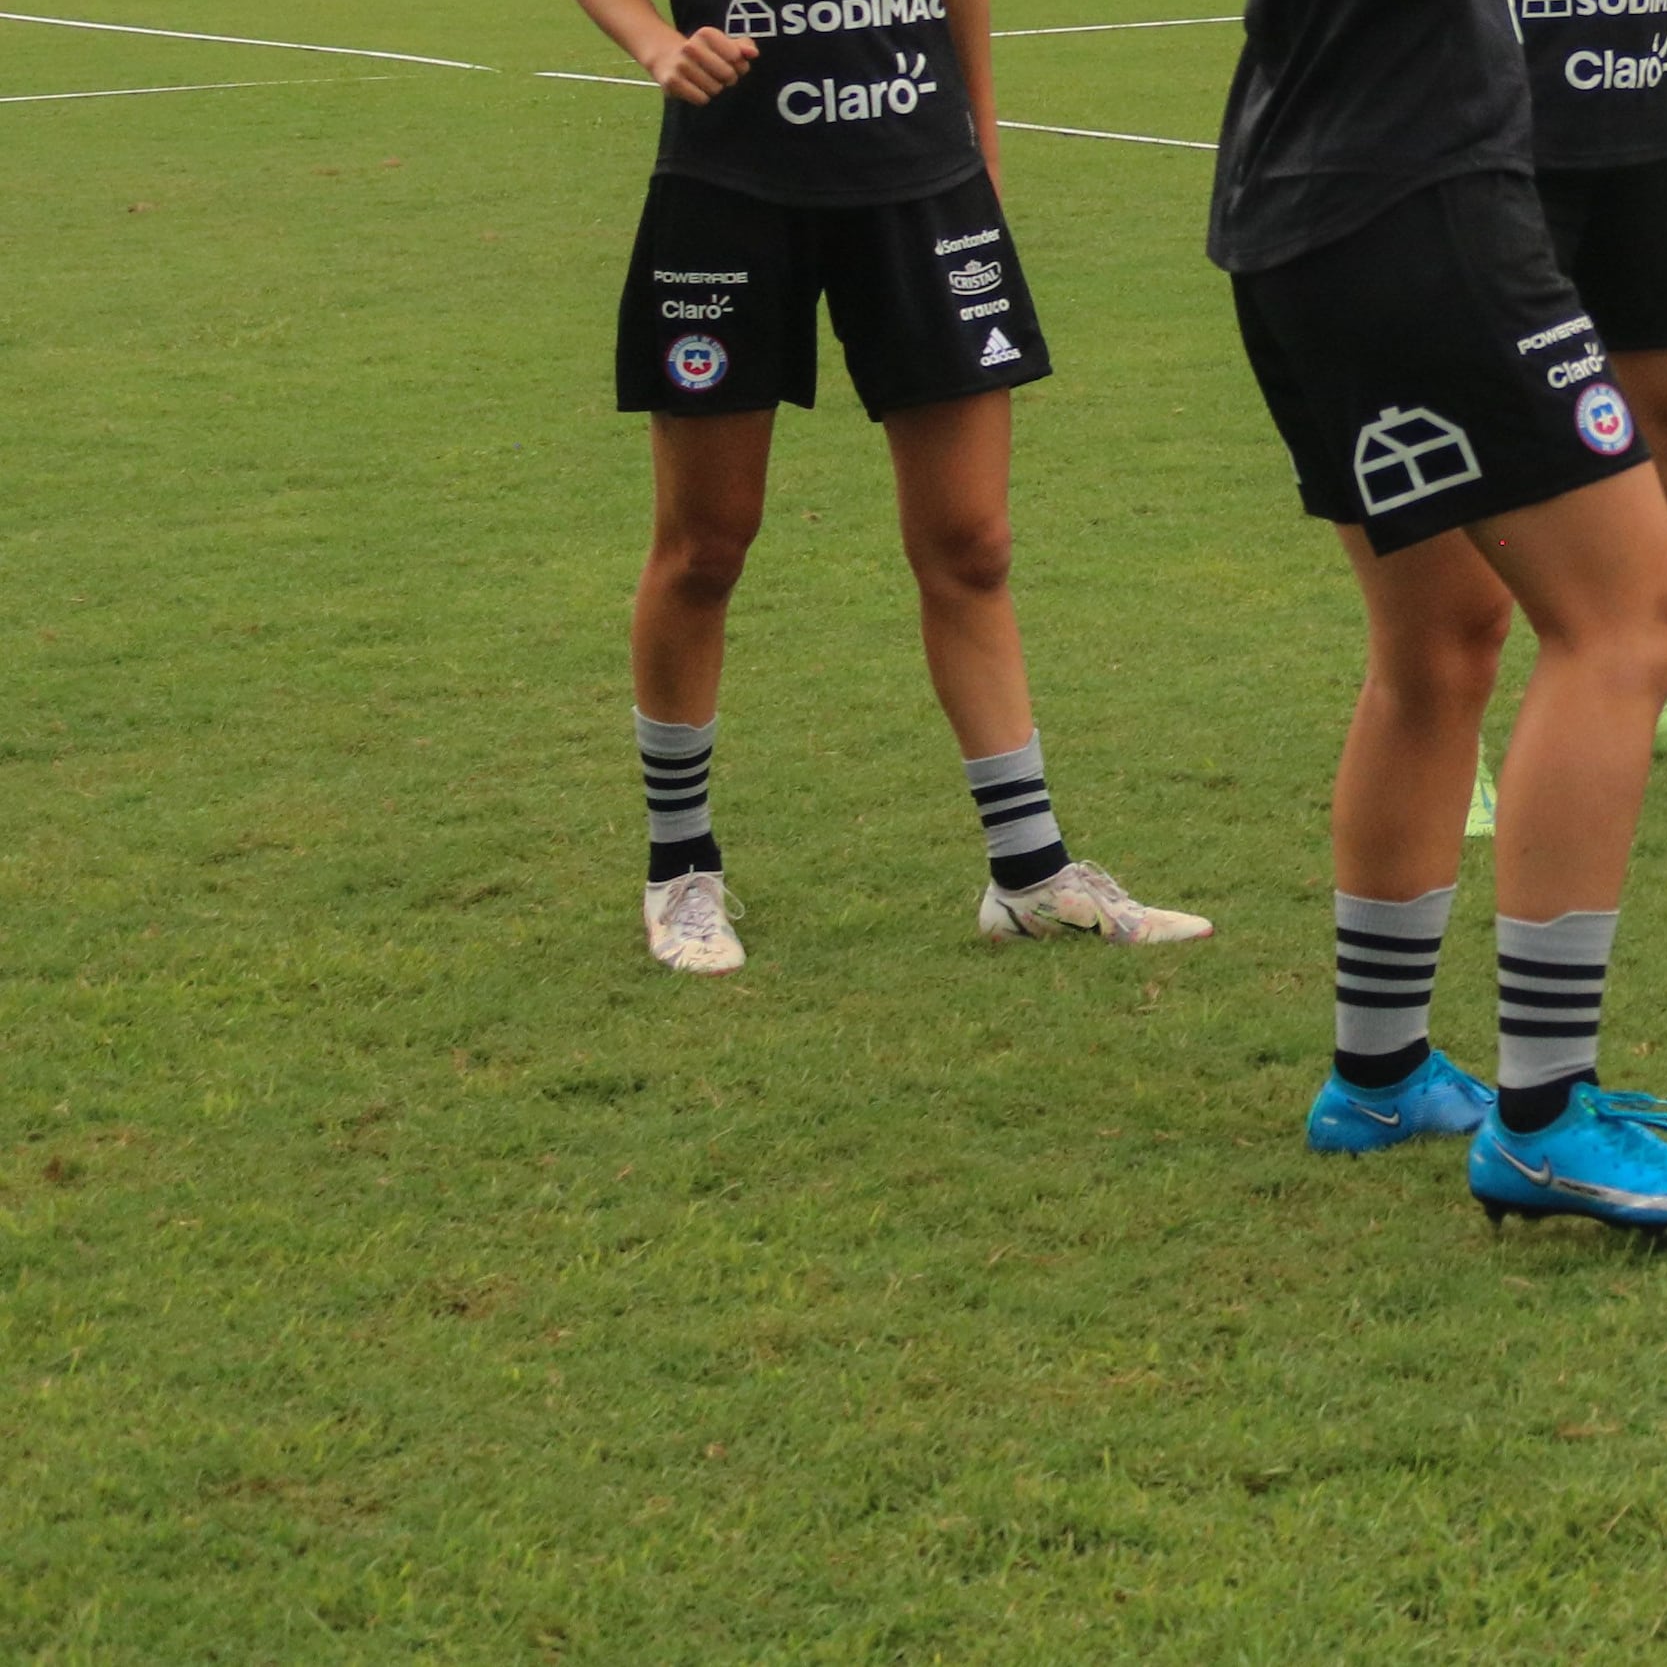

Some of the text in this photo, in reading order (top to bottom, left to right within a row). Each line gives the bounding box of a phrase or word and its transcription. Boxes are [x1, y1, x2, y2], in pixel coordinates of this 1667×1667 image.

[1565, 50, 1663, 90] Claro
[777, 78, 918, 125] Claro
[941, 228, 1000, 253] Santander
[653, 270, 748, 284] POWERADE
[955, 269, 998, 289] CRISTAL
[661, 300, 721, 320] Claro
[960, 298, 1010, 321] arauco
[981, 348, 1021, 366] adidas
[1547, 355, 1603, 389] Claro
